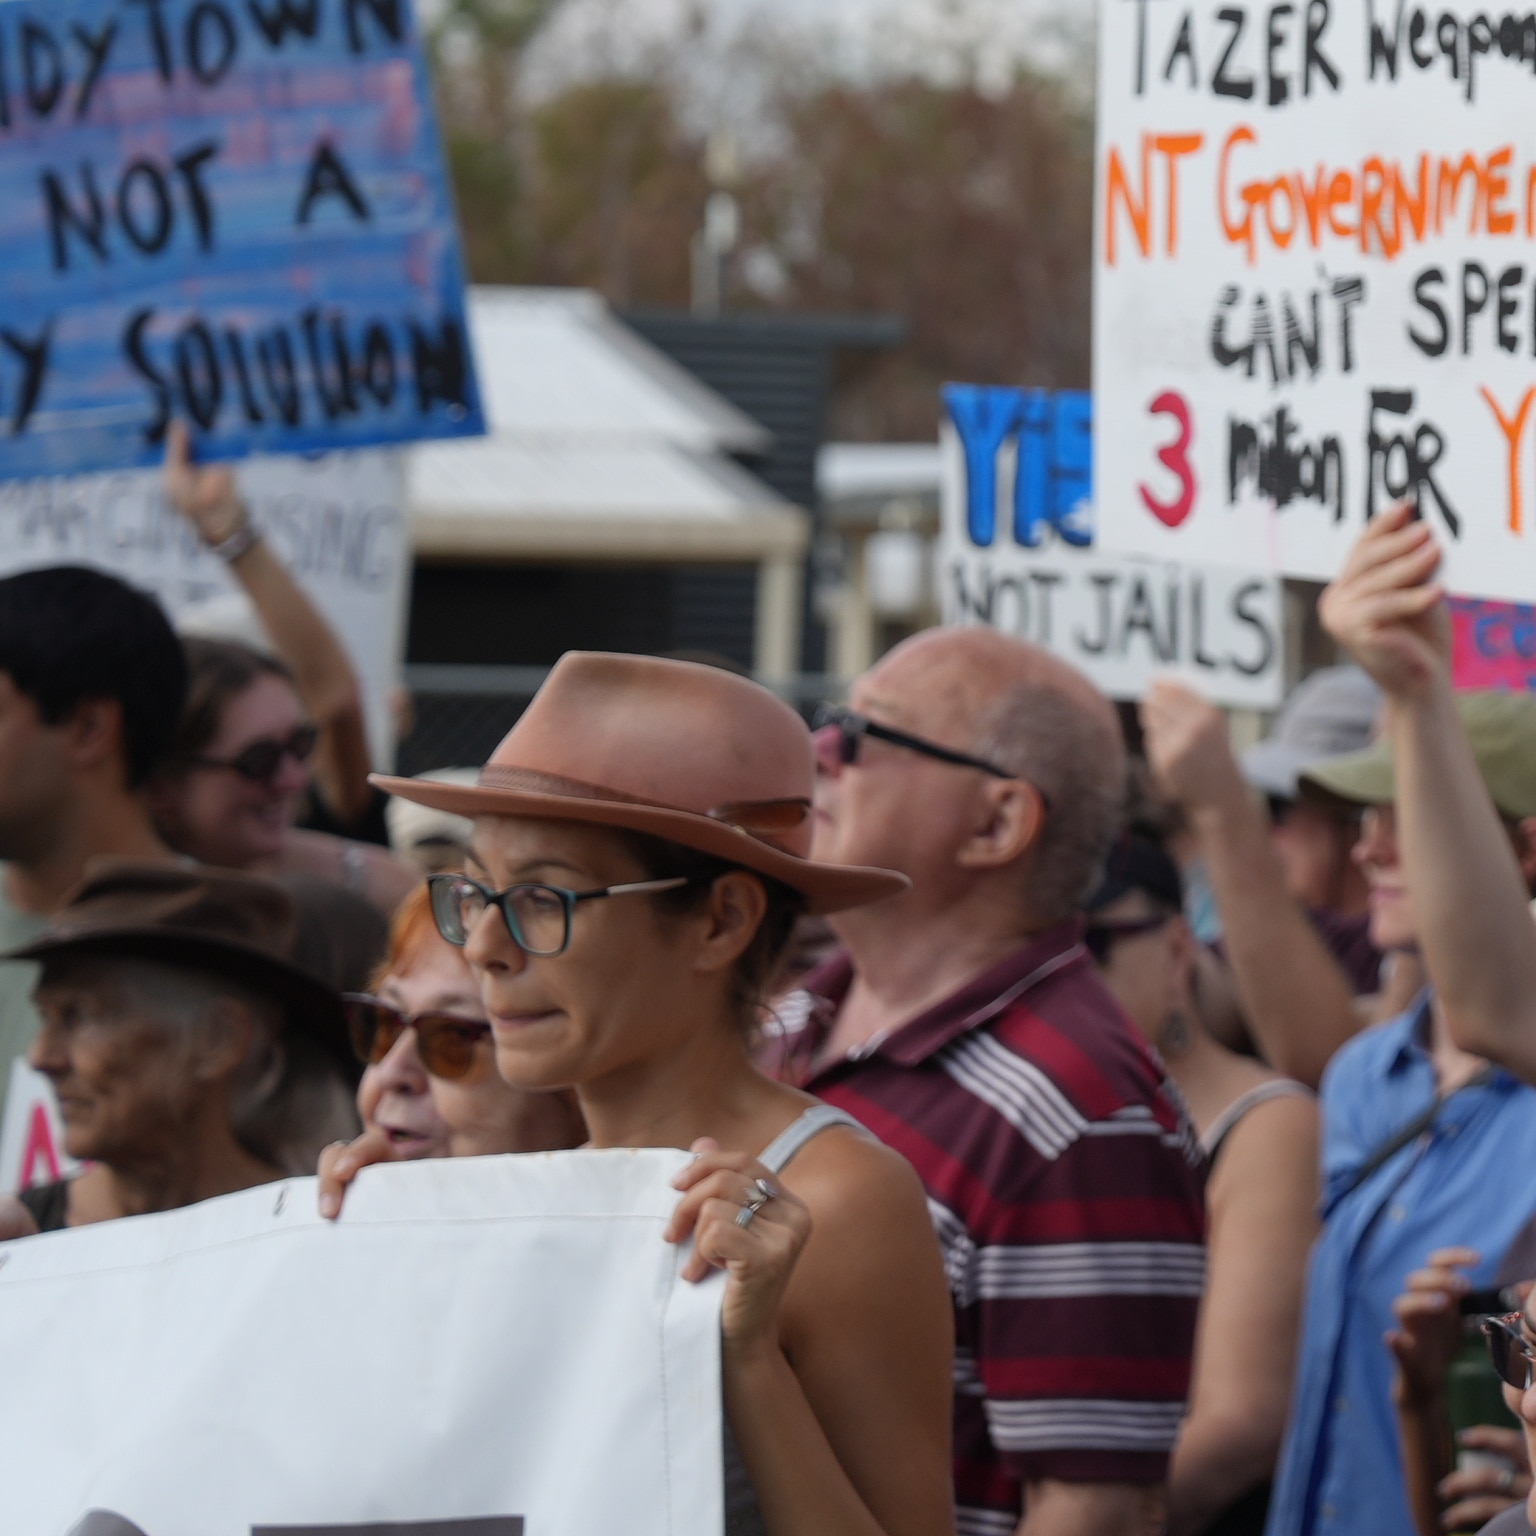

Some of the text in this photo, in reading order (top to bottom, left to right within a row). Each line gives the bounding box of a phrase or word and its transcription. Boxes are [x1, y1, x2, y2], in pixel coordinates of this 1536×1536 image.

[41, 134, 368, 272] NOT A
[1104, 127, 1205, 268] NT
[1139, 390, 1198, 530] 3
[952, 560, 1063, 654] NOT
